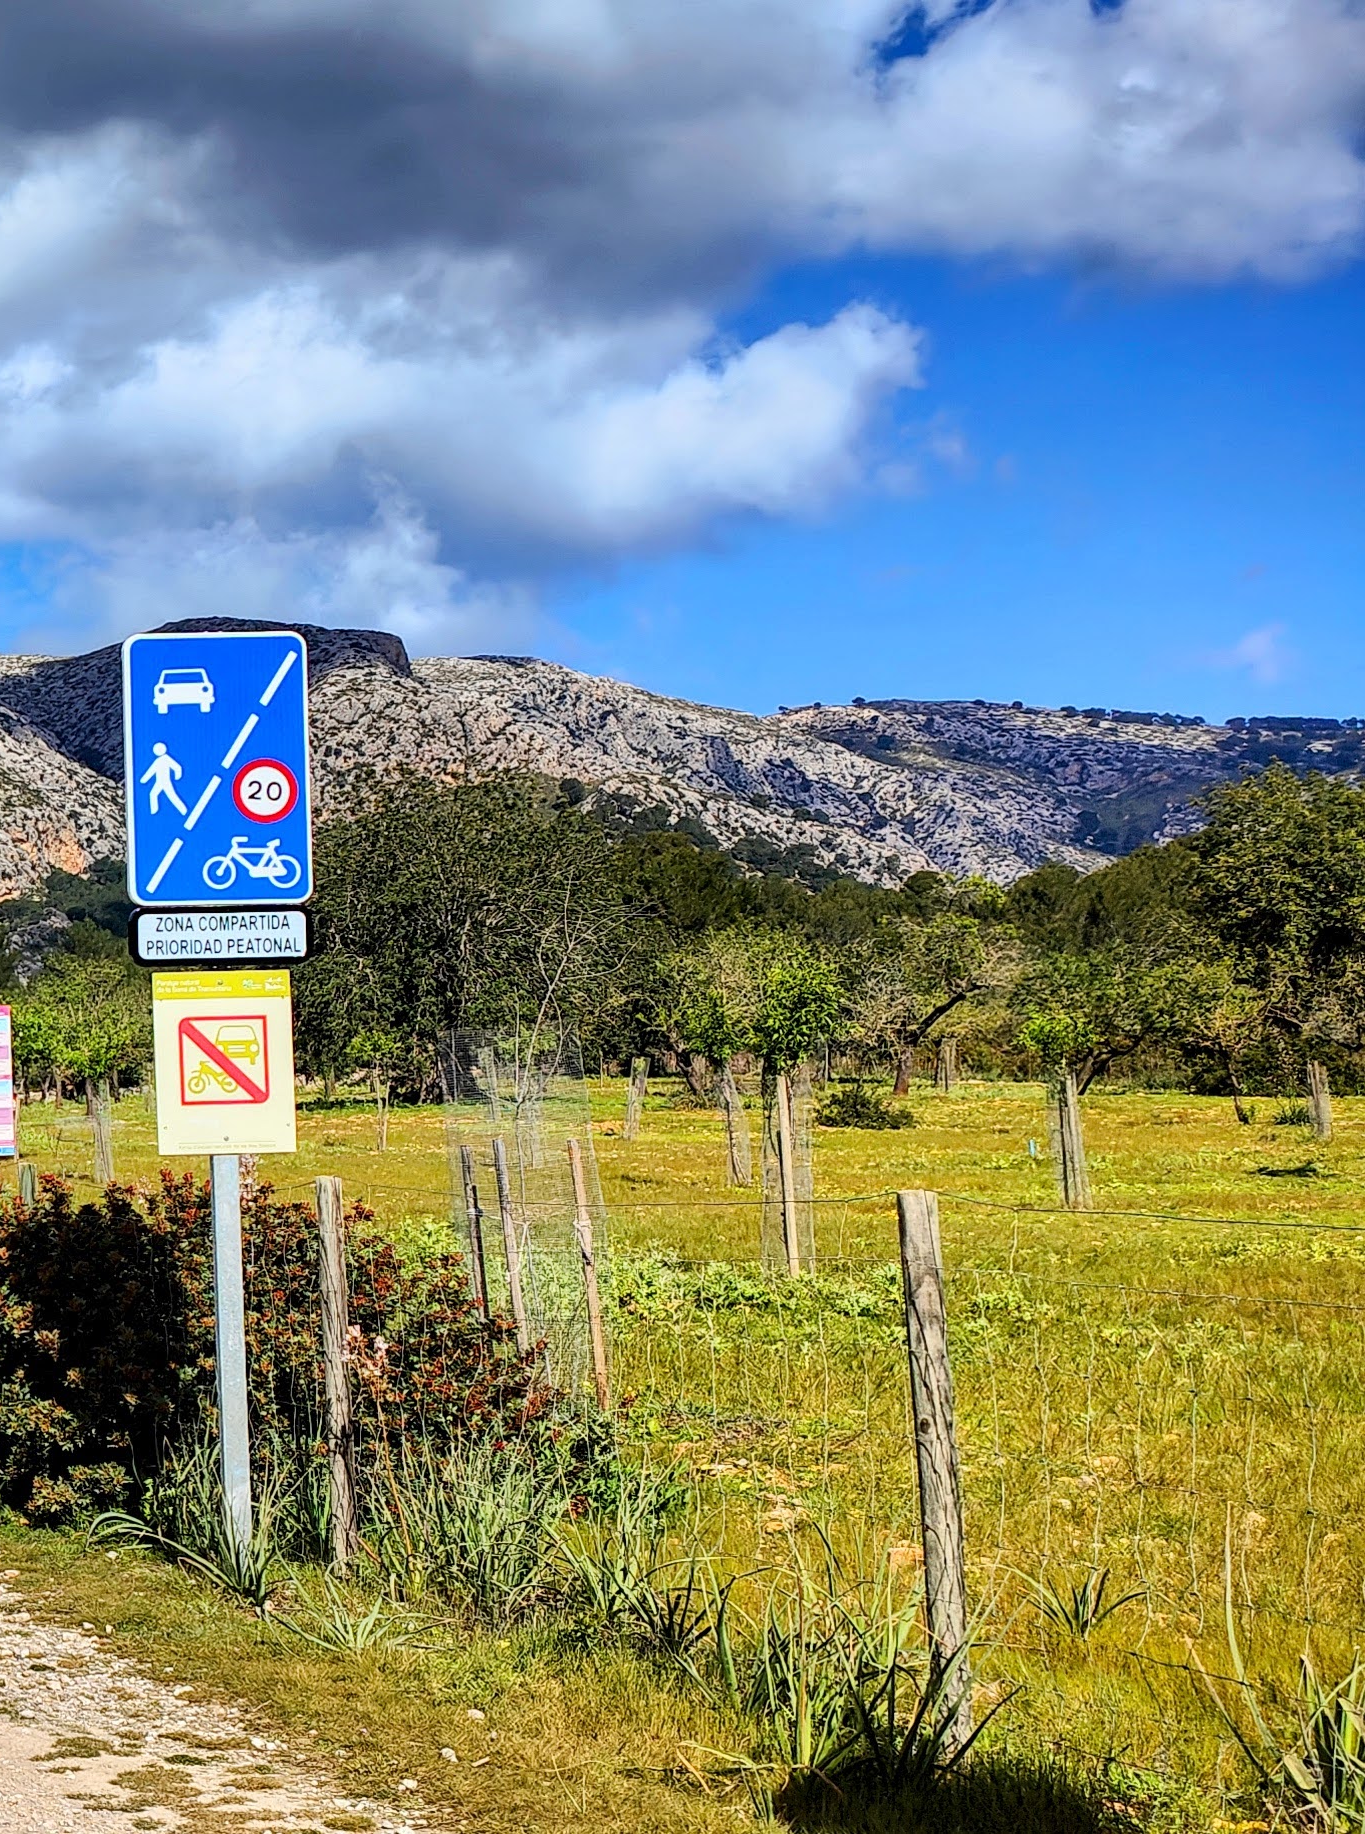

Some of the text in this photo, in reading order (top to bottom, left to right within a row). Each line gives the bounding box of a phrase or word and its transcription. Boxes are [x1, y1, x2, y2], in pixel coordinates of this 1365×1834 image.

[247, 780, 282, 802] 20
[155, 914, 291, 932] ZONA COMPARTIDA
[146, 937, 302, 956] PRIORIDAD PEATONAL
